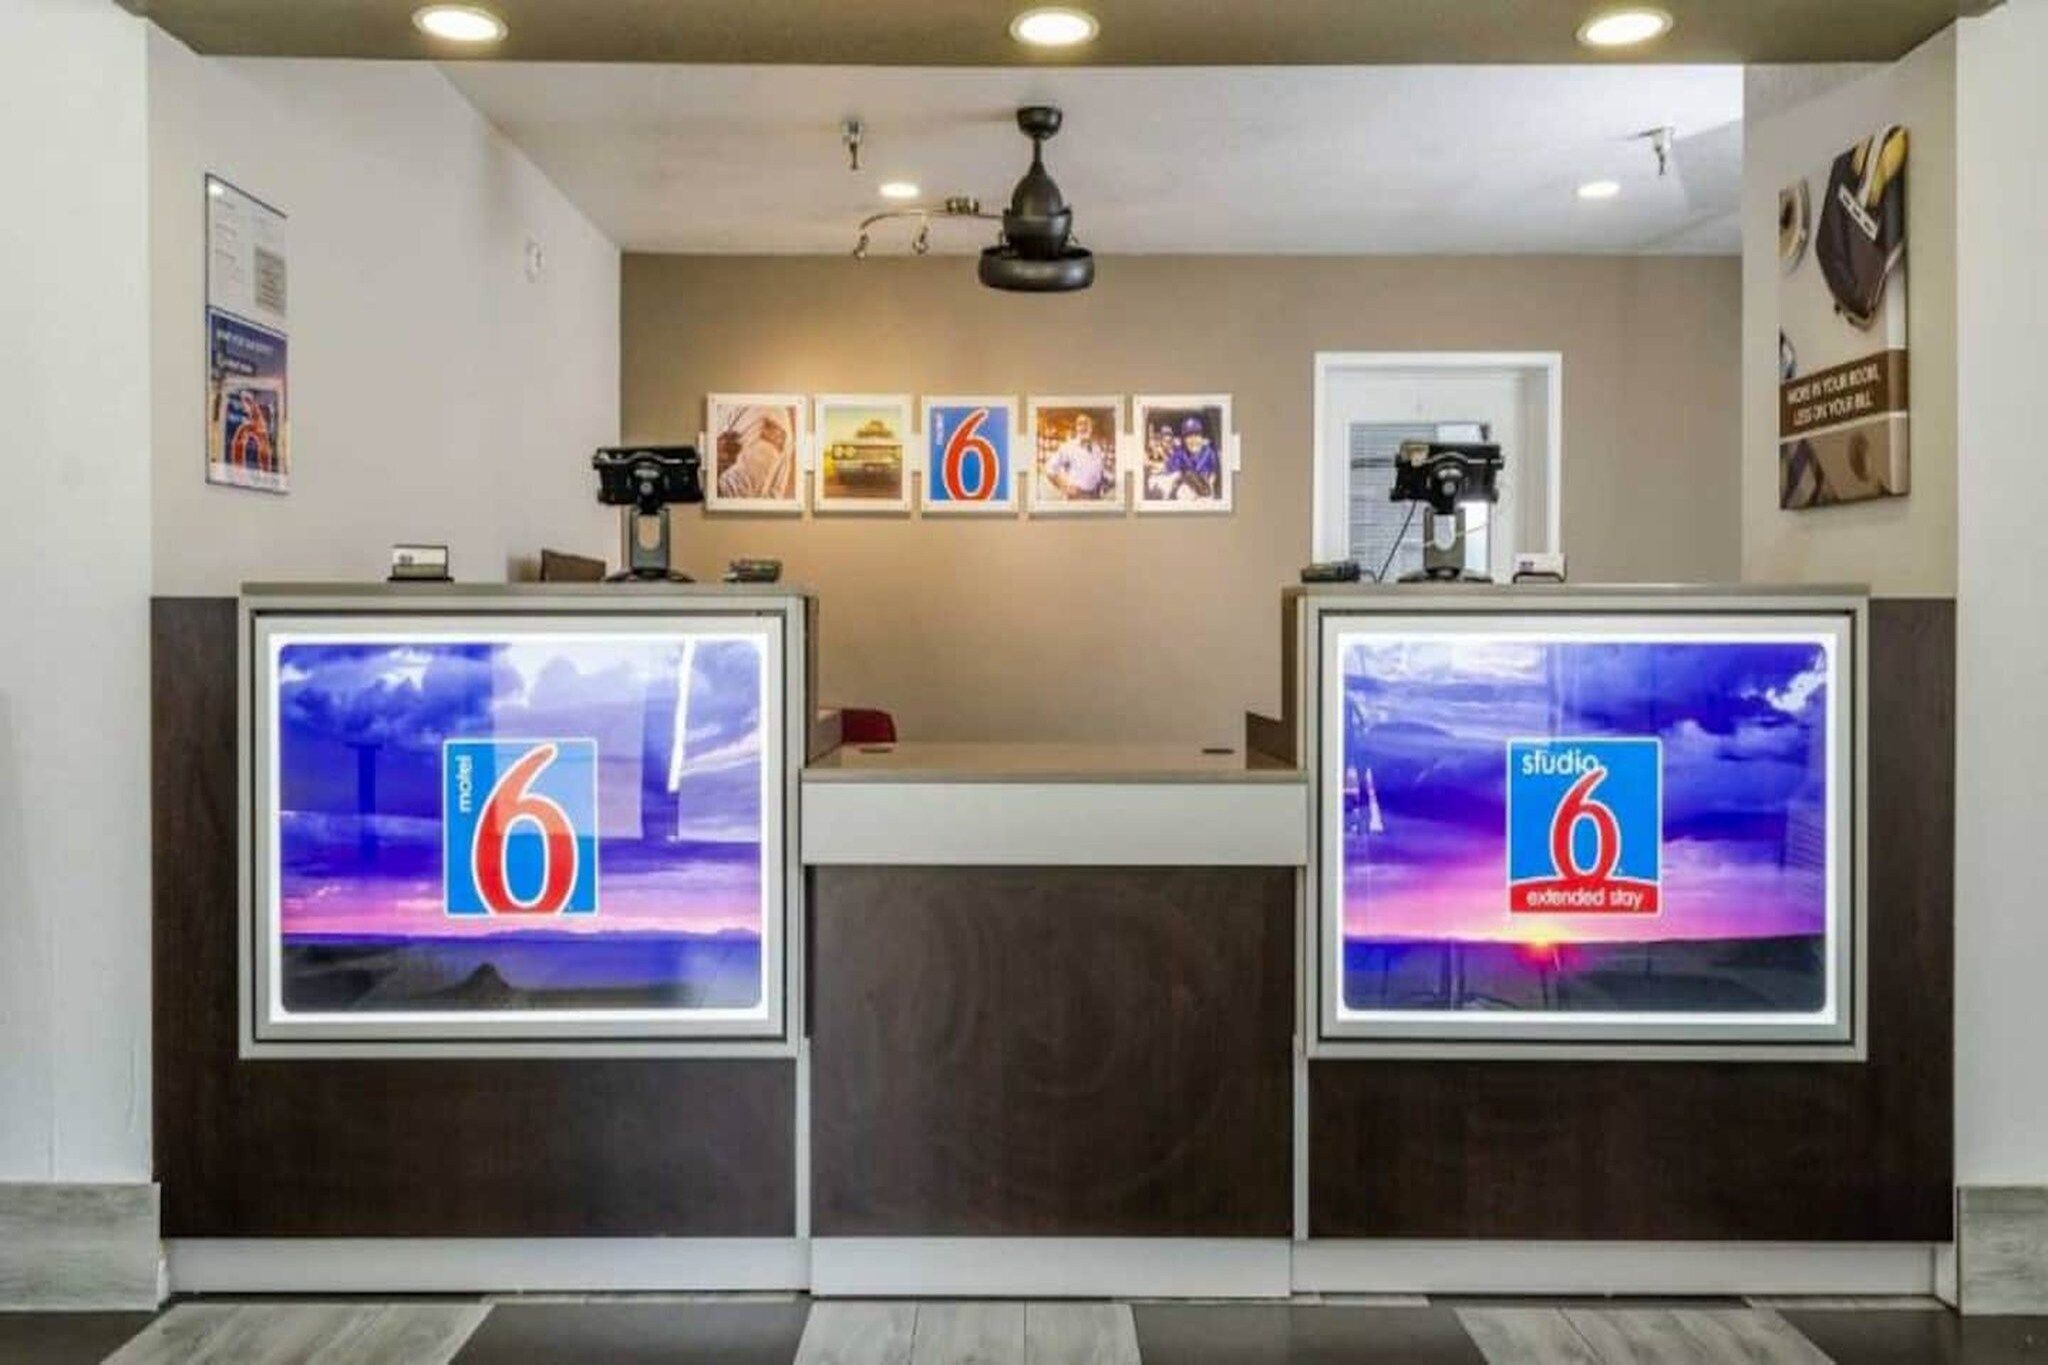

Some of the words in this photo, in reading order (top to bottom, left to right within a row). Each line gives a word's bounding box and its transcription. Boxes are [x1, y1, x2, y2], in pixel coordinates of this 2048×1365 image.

[942, 408, 1000, 502] 6
[455, 754, 473, 813] motel
[1522, 749, 1599, 775] studio
[471, 742, 579, 916] 6
[1550, 767, 1621, 881] 6
[1526, 888, 1605, 906] extended
[1610, 888, 1644, 911] stay
